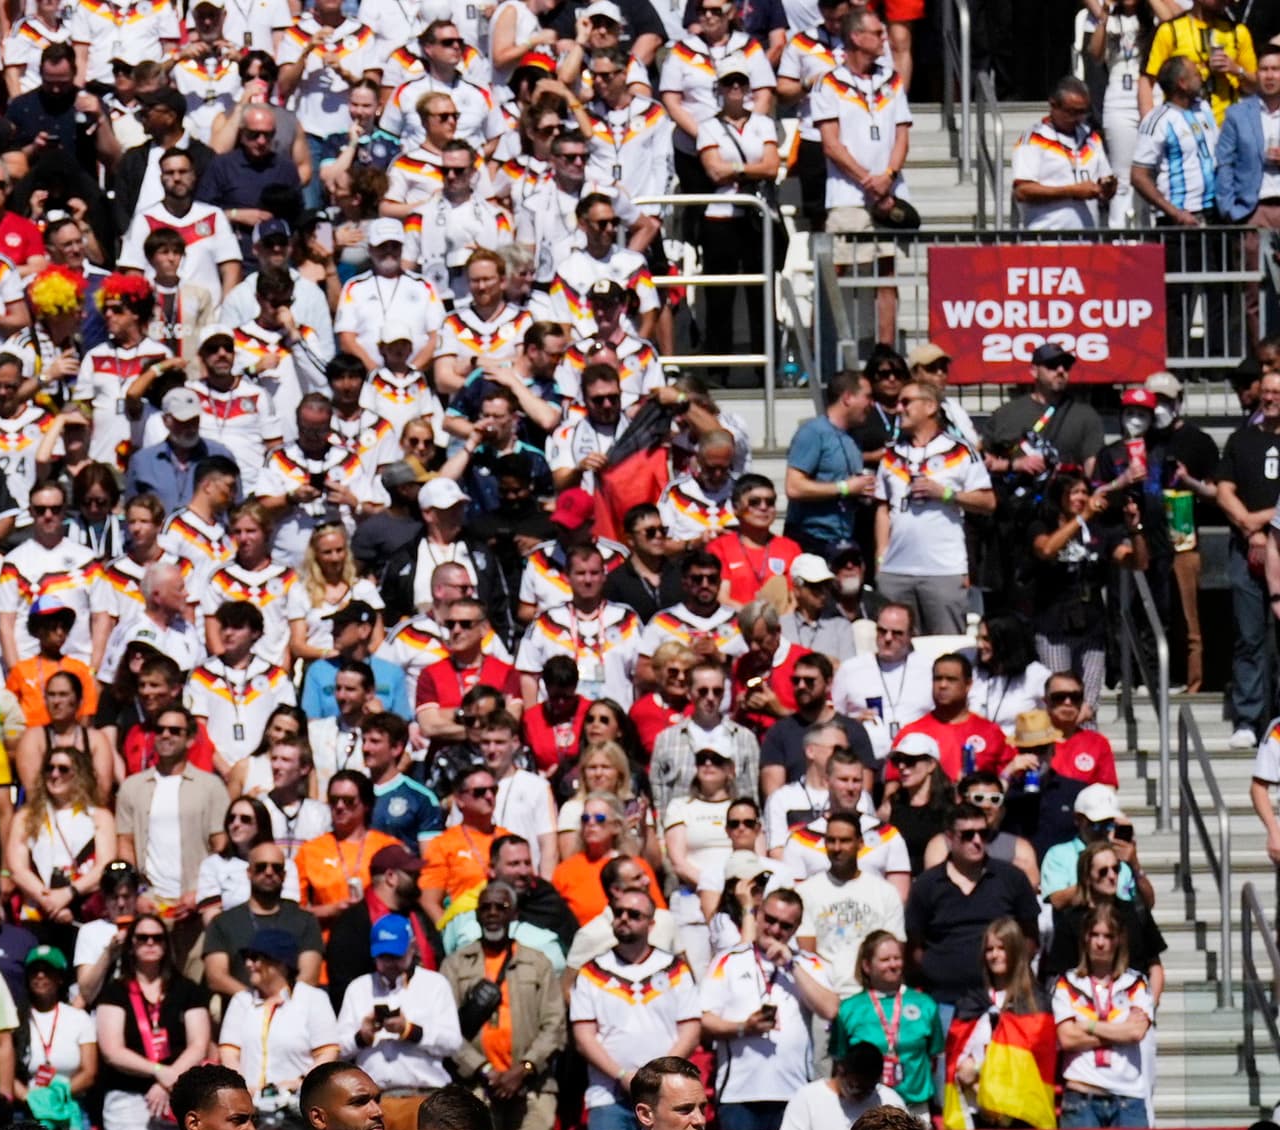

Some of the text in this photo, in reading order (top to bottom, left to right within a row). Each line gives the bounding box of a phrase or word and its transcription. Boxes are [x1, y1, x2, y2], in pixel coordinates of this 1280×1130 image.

[1007, 267, 1085, 295] FIFA
[942, 300, 1153, 329] WORLD CUP
